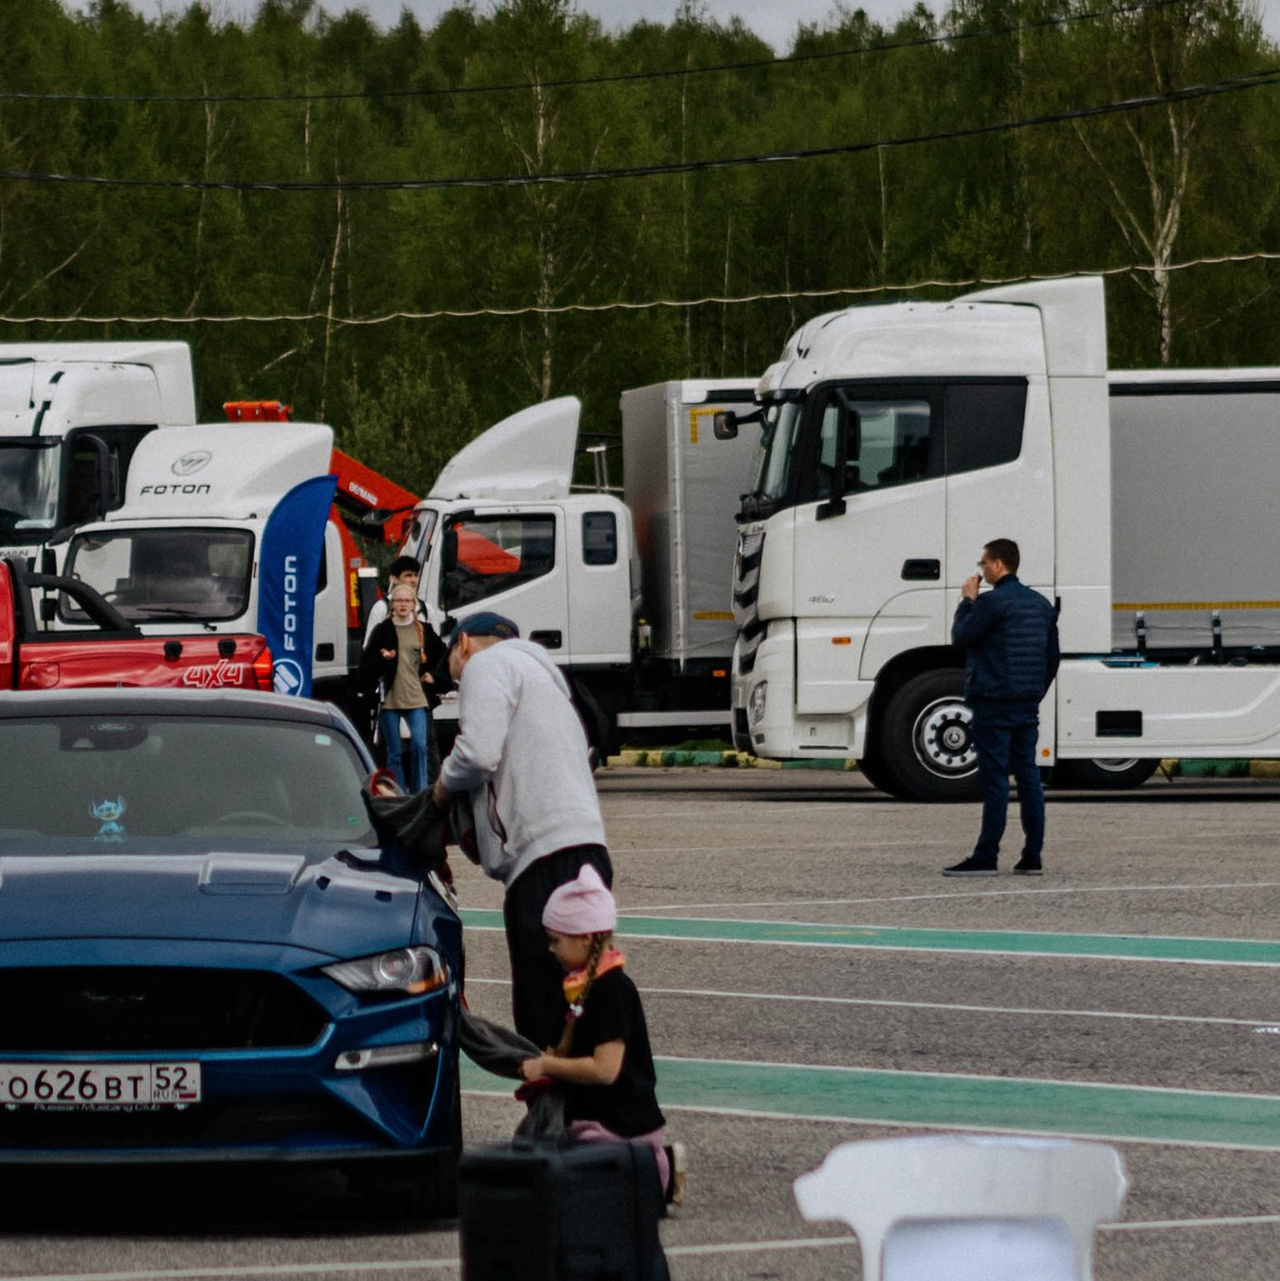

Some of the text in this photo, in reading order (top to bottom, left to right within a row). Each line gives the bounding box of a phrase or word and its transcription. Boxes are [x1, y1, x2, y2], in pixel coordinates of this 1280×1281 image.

[140, 483, 211, 497] FOTON
[283, 555, 298, 652] FOTON
[155, 1066, 188, 1091] 52
[153, 1090, 178, 1101] RUS
